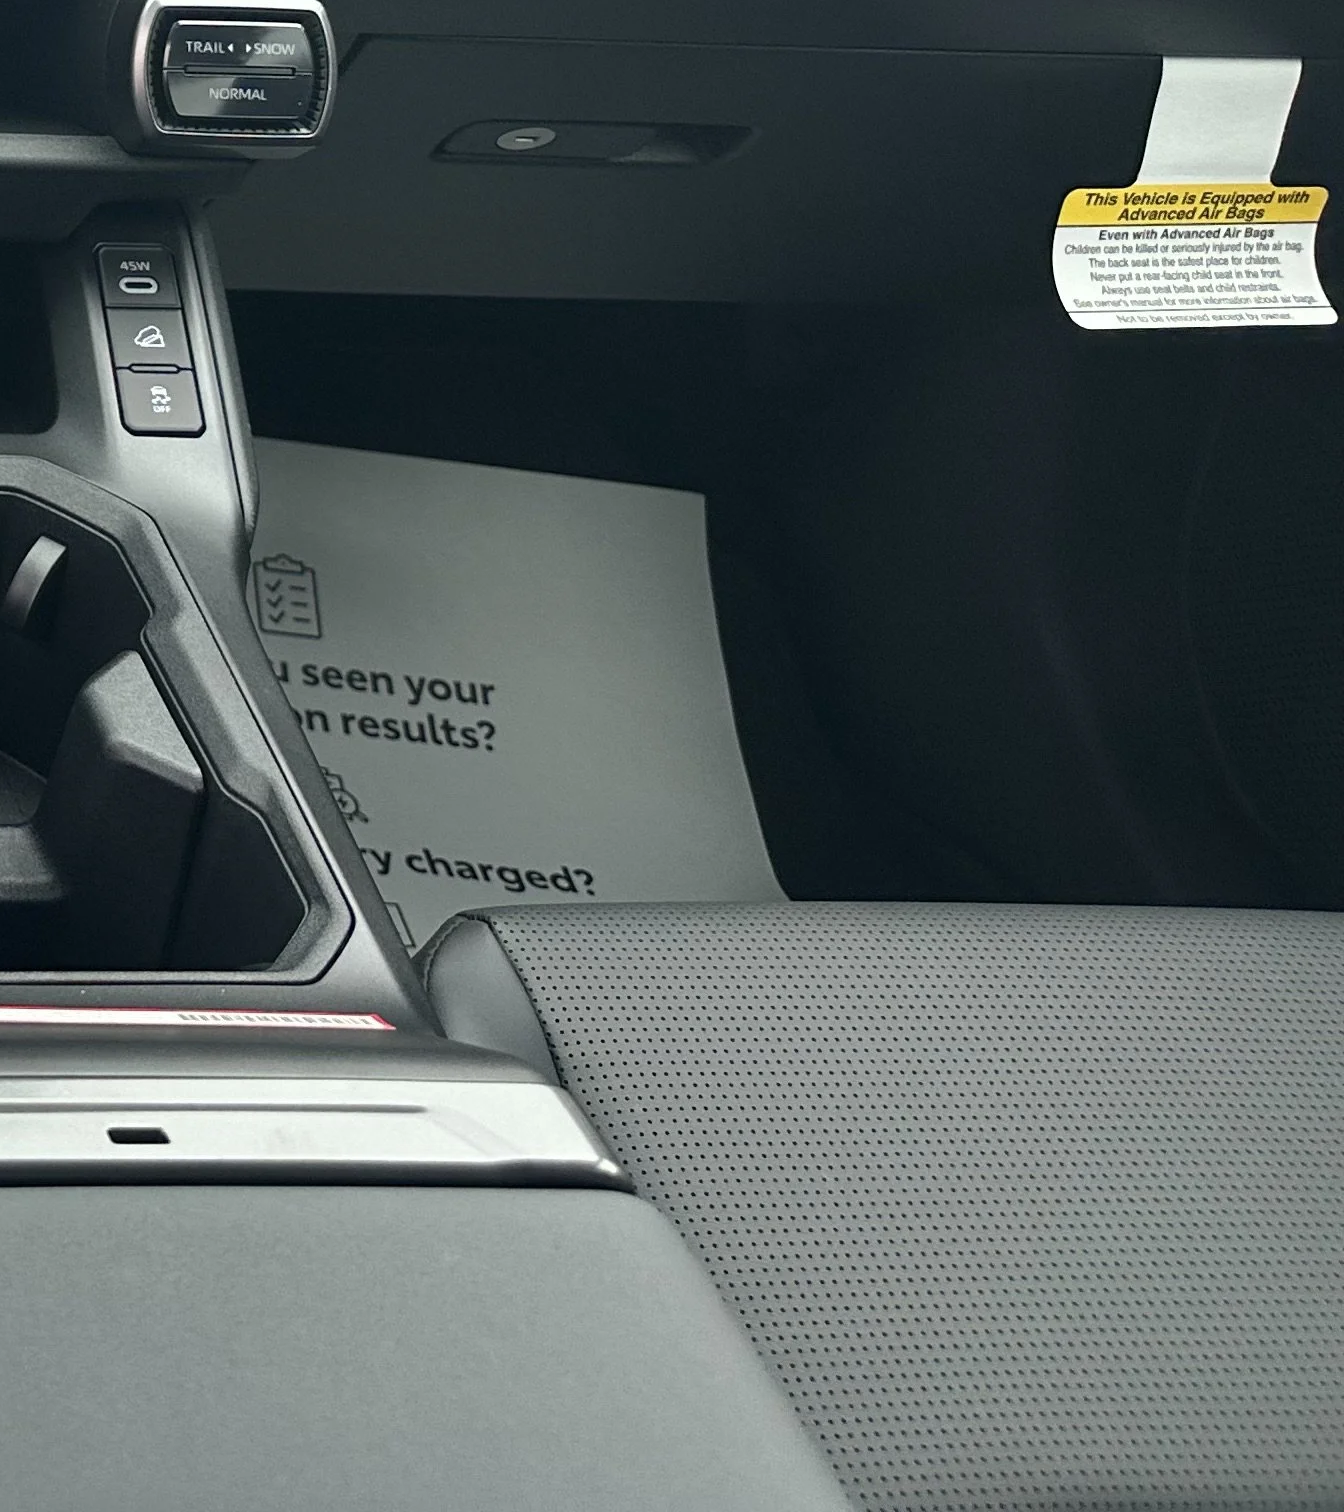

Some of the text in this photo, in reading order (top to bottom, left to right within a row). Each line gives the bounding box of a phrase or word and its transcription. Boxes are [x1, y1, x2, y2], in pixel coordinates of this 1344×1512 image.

[185, 40, 225, 54] TRAIL
[253, 42, 296, 56] SNOW
[208, 88, 267, 101] NORMAL
[1085, 190, 1310, 209] This Vehicle is Equipped with
[1117, 207, 1265, 222] Advanced Air Bags
[1099, 227, 1275, 241] Even with Advanced Air Bags
[1064, 244, 1101, 255] Children
[1103, 246, 1119, 254] can
[1122, 244, 1133, 254] be
[1135, 244, 1158, 254] killed
[1160, 245, 1169, 253] or
[1172, 243, 1210, 254] seriously
[1212, 242, 1241, 254] injured
[1244, 242, 1254, 253] by
[1256, 241, 1269, 252] the
[1272, 240, 1282, 251] air
[120, 260, 151, 271] 45W
[153, 405, 171, 414] OFF
[301, 661, 395, 695] seen
[404, 674, 496, 706] your
[341, 712, 497, 752] results?
[405, 848, 596, 896] charged?
